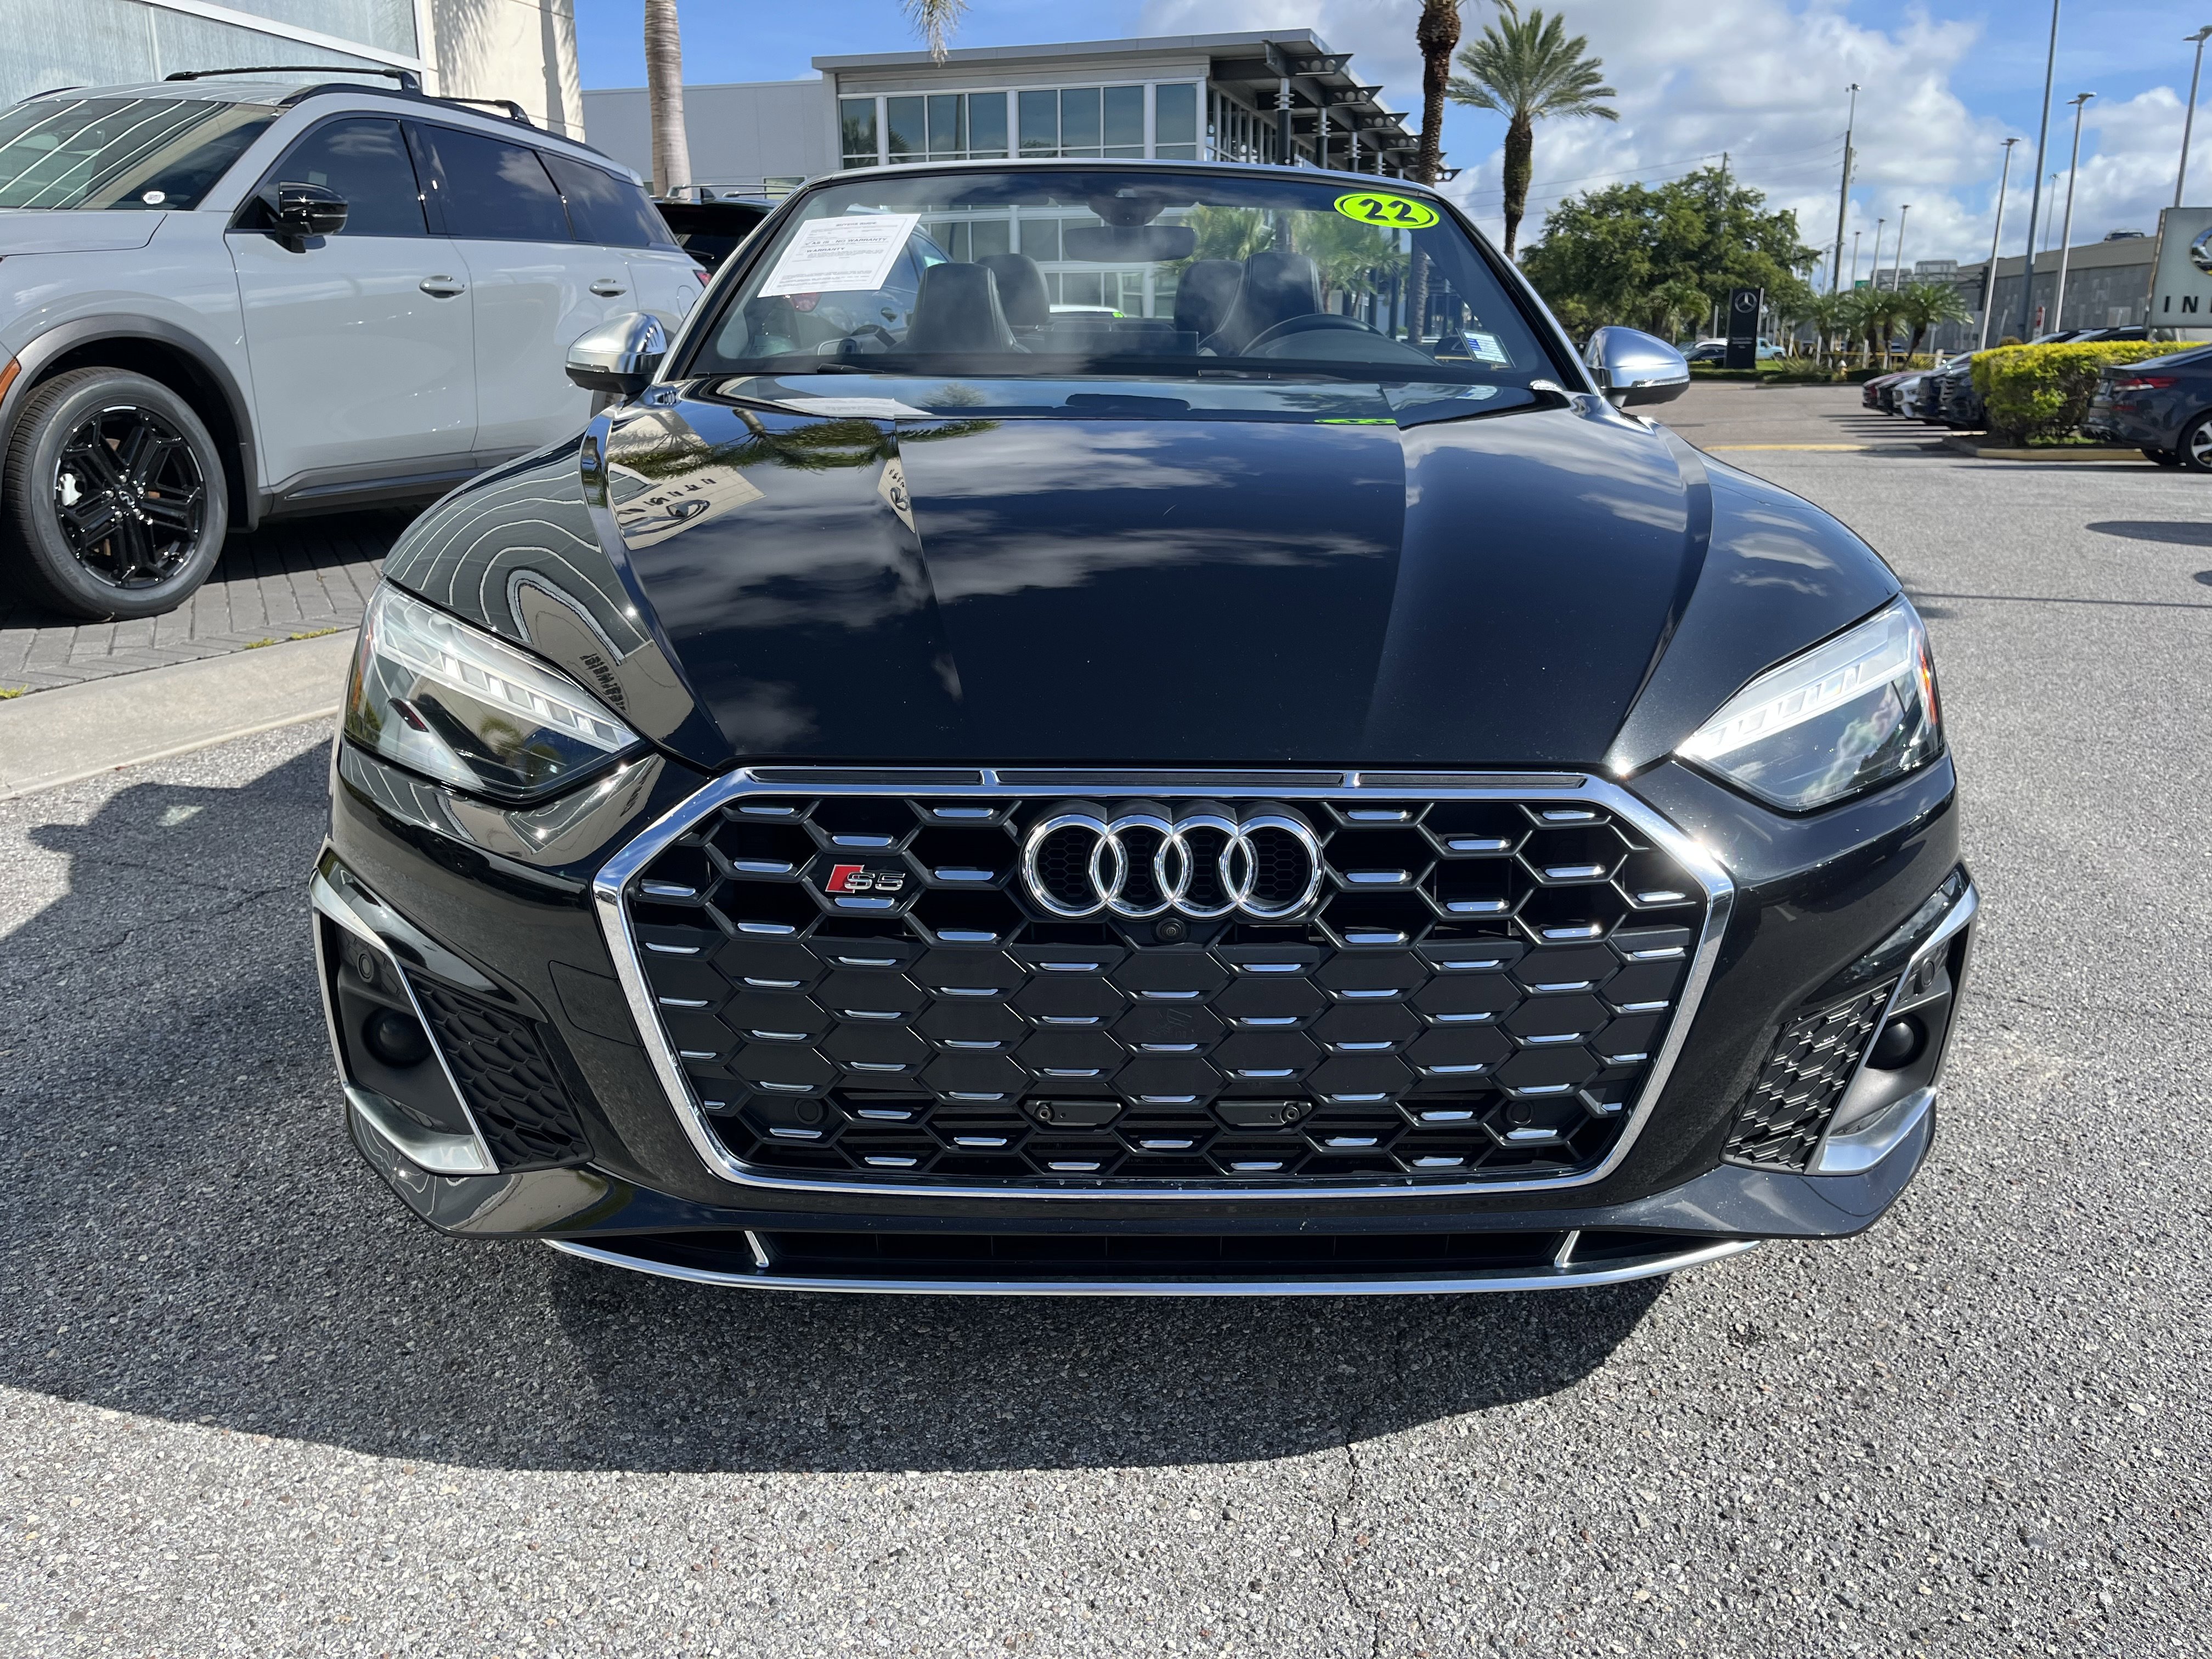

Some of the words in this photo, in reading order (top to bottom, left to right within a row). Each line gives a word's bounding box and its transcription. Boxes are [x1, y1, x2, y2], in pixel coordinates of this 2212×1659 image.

[1357, 198, 1419, 223] 22
[2164, 296, 2212, 313] IN
[844, 872, 906, 891] S5
